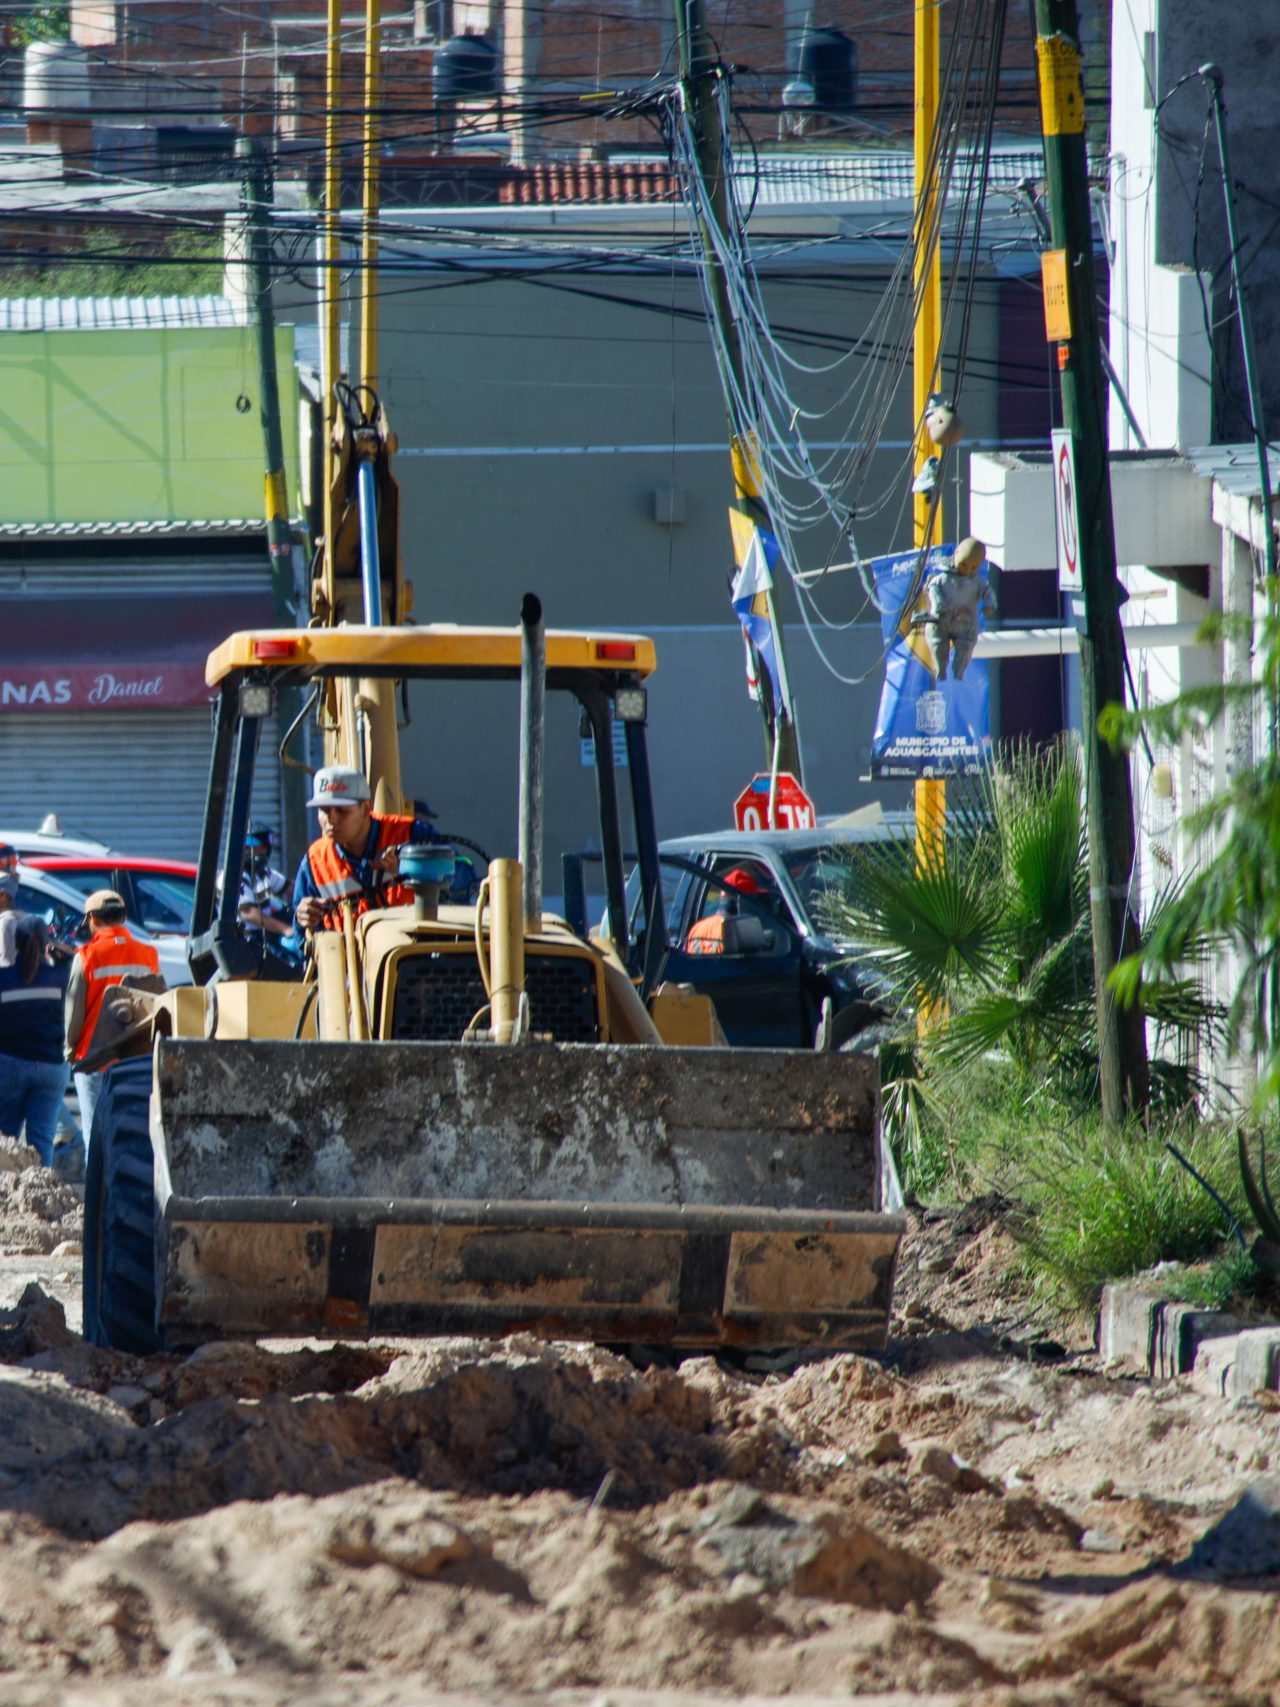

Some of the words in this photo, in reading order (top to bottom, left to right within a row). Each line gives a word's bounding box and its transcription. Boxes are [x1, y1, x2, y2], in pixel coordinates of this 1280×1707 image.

[88, 674, 163, 704] Daniel
[896, 736, 950, 747] MUNICIPIO
[951, 736, 967, 746] DE
